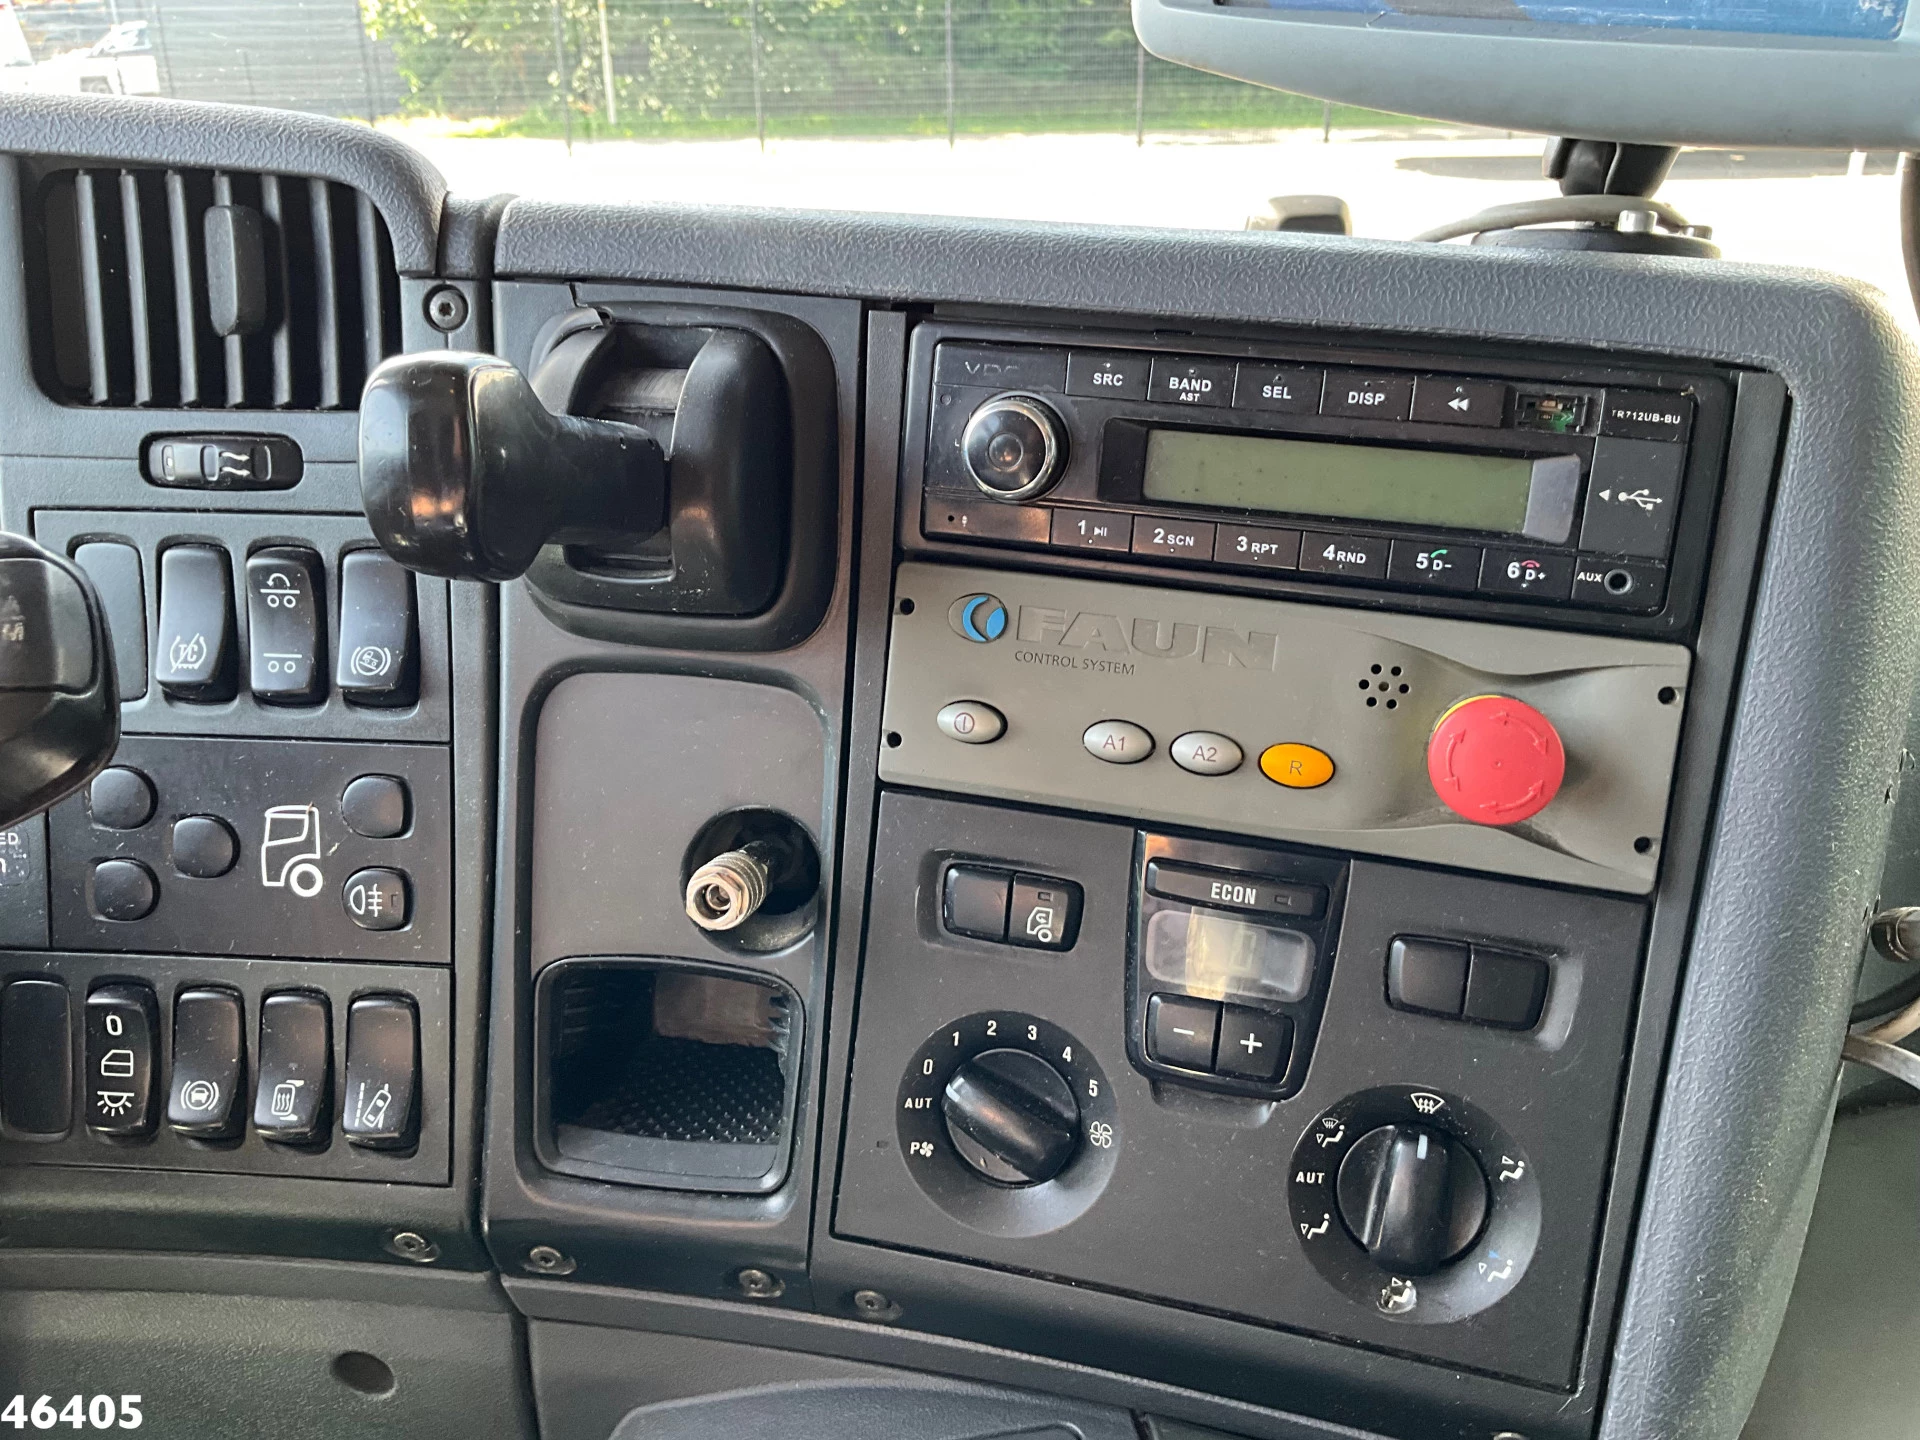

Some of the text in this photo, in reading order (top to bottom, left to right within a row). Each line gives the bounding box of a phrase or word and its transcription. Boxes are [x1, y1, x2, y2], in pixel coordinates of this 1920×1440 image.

[1092, 372, 1124, 387] SRC
[1169, 377, 1212, 393] BAND
[1179, 392, 1200, 402] AST
[1262, 384, 1292, 400] SEL
[1347, 391, 1386, 406] DISP
[1612, 409, 1680, 424] TR712UB-BU
[1077, 520, 1086, 536] 1
[1153, 528, 1194, 547] 2 SCN
[1236, 536, 1278, 555] 3 RPT
[1416, 552, 1428, 569] 5
[1507, 561, 1520, 579] 6
[1577, 571, 1602, 583] AUX
[1016, 604, 1279, 672] FAUN
[1014, 651, 1135, 676] CONTROL SYSTEM
[1102, 734, 1127, 752] A1
[1191, 745, 1218, 763] A2
[1288, 759, 1304, 776] R
[1210, 882, 1257, 905] ECON
[106, 1015, 123, 1036] 0
[986, 1020, 997, 1036] 2
[1027, 1025, 1038, 1041] 3
[952, 1031, 961, 1046] 1
[1062, 1046, 1072, 1062] 4
[923, 1058, 934, 1075] 0
[1088, 1079, 1098, 1097] 5
[904, 1097, 932, 1109] AUT
[1295, 1171, 1325, 1185] AUT
